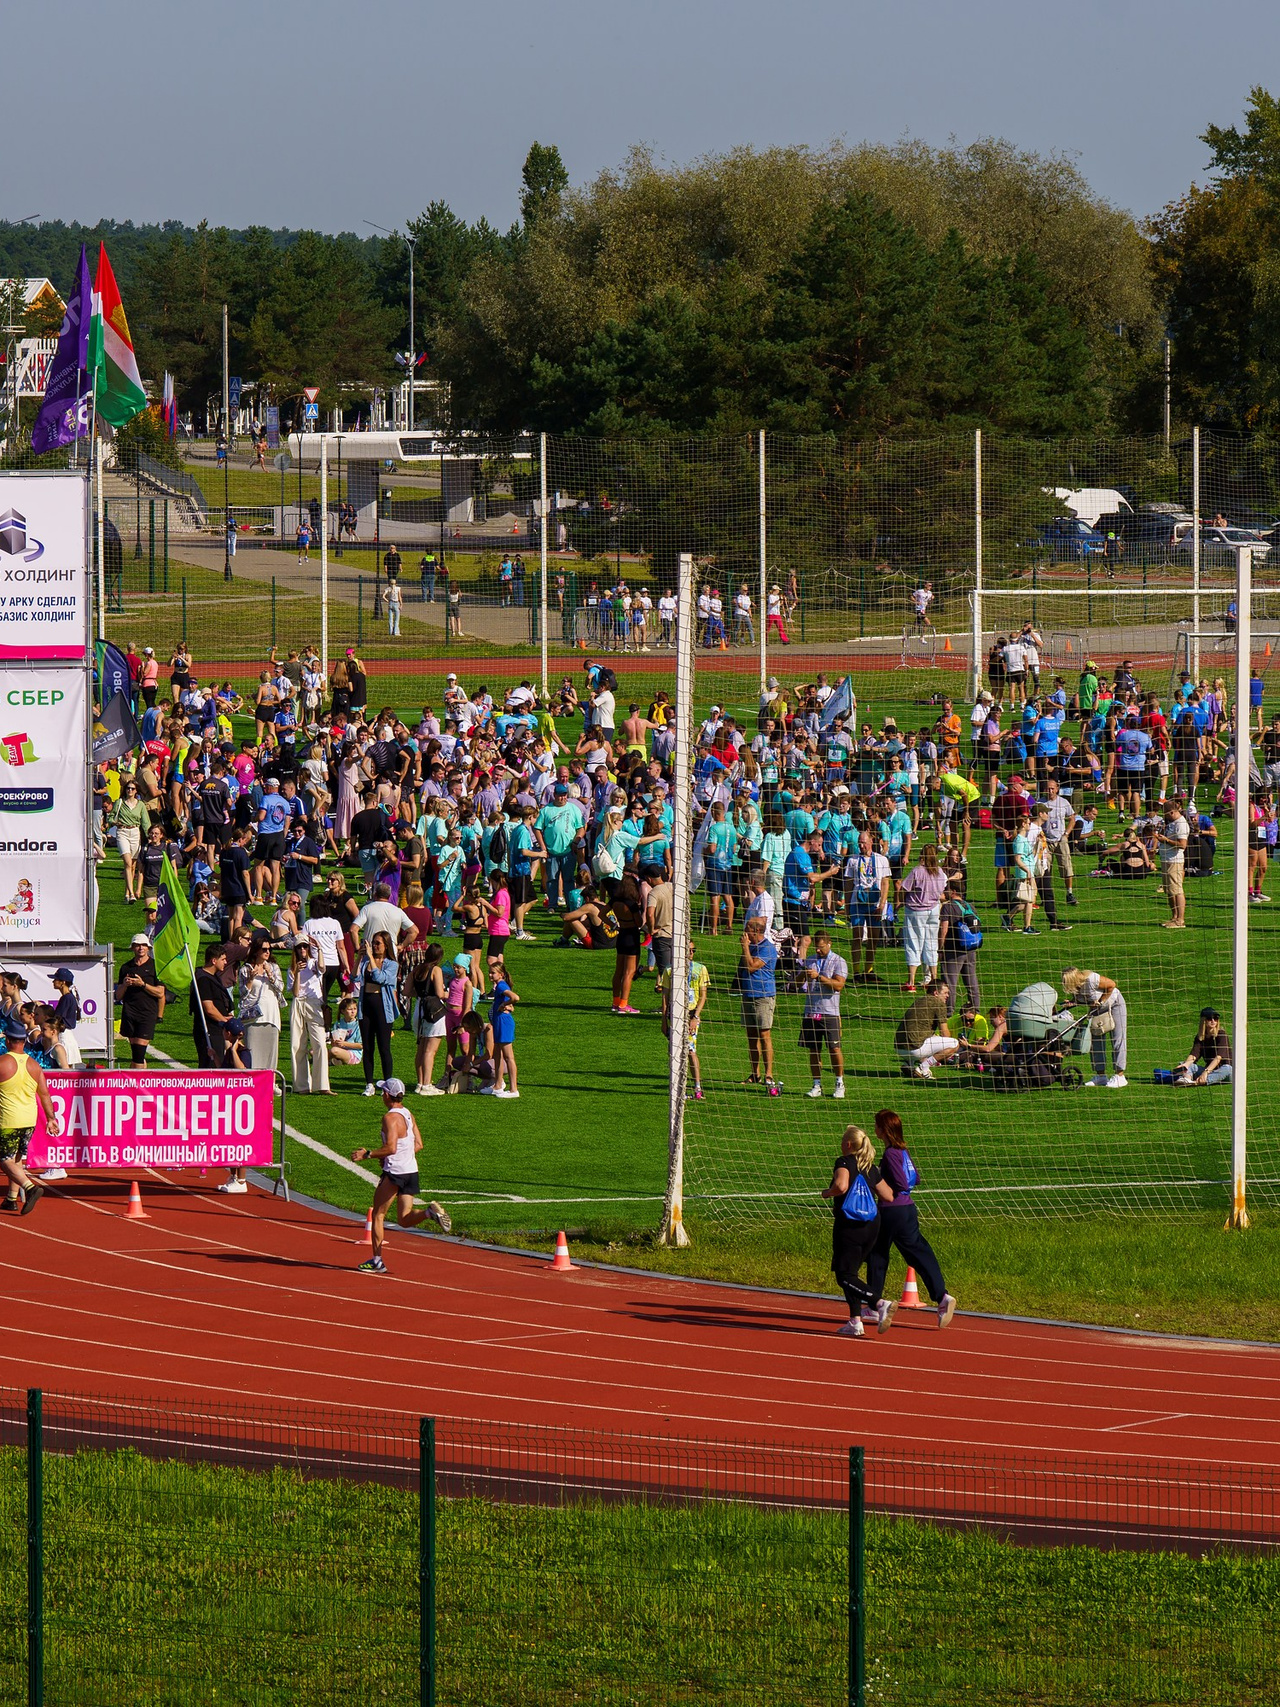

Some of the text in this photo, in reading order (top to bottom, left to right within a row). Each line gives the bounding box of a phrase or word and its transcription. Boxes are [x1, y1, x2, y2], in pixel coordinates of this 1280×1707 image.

[4, 569, 77, 584] ХОЛДИНГ
[9, 596, 34, 607] АРКУ
[37, 596, 76, 608] СДЕЛАЛ
[31, 611, 76, 623] ХОЛДИНГ
[6, 690, 65, 706] СБЕР
[0, 916, 41, 928] Маруся
[46, 1075, 255, 1090] РОДИТЕЛЯМ И ЛИЦАМ, СОПРОВОЖДАЮЩИМ ДЕТЕЙ,
[49, 1094, 255, 1141] ЗАПРЕЩЕНО
[47, 1142, 253, 1164] ВБЕГАТЬ В ФИНИШНЫЙ СТВОР
